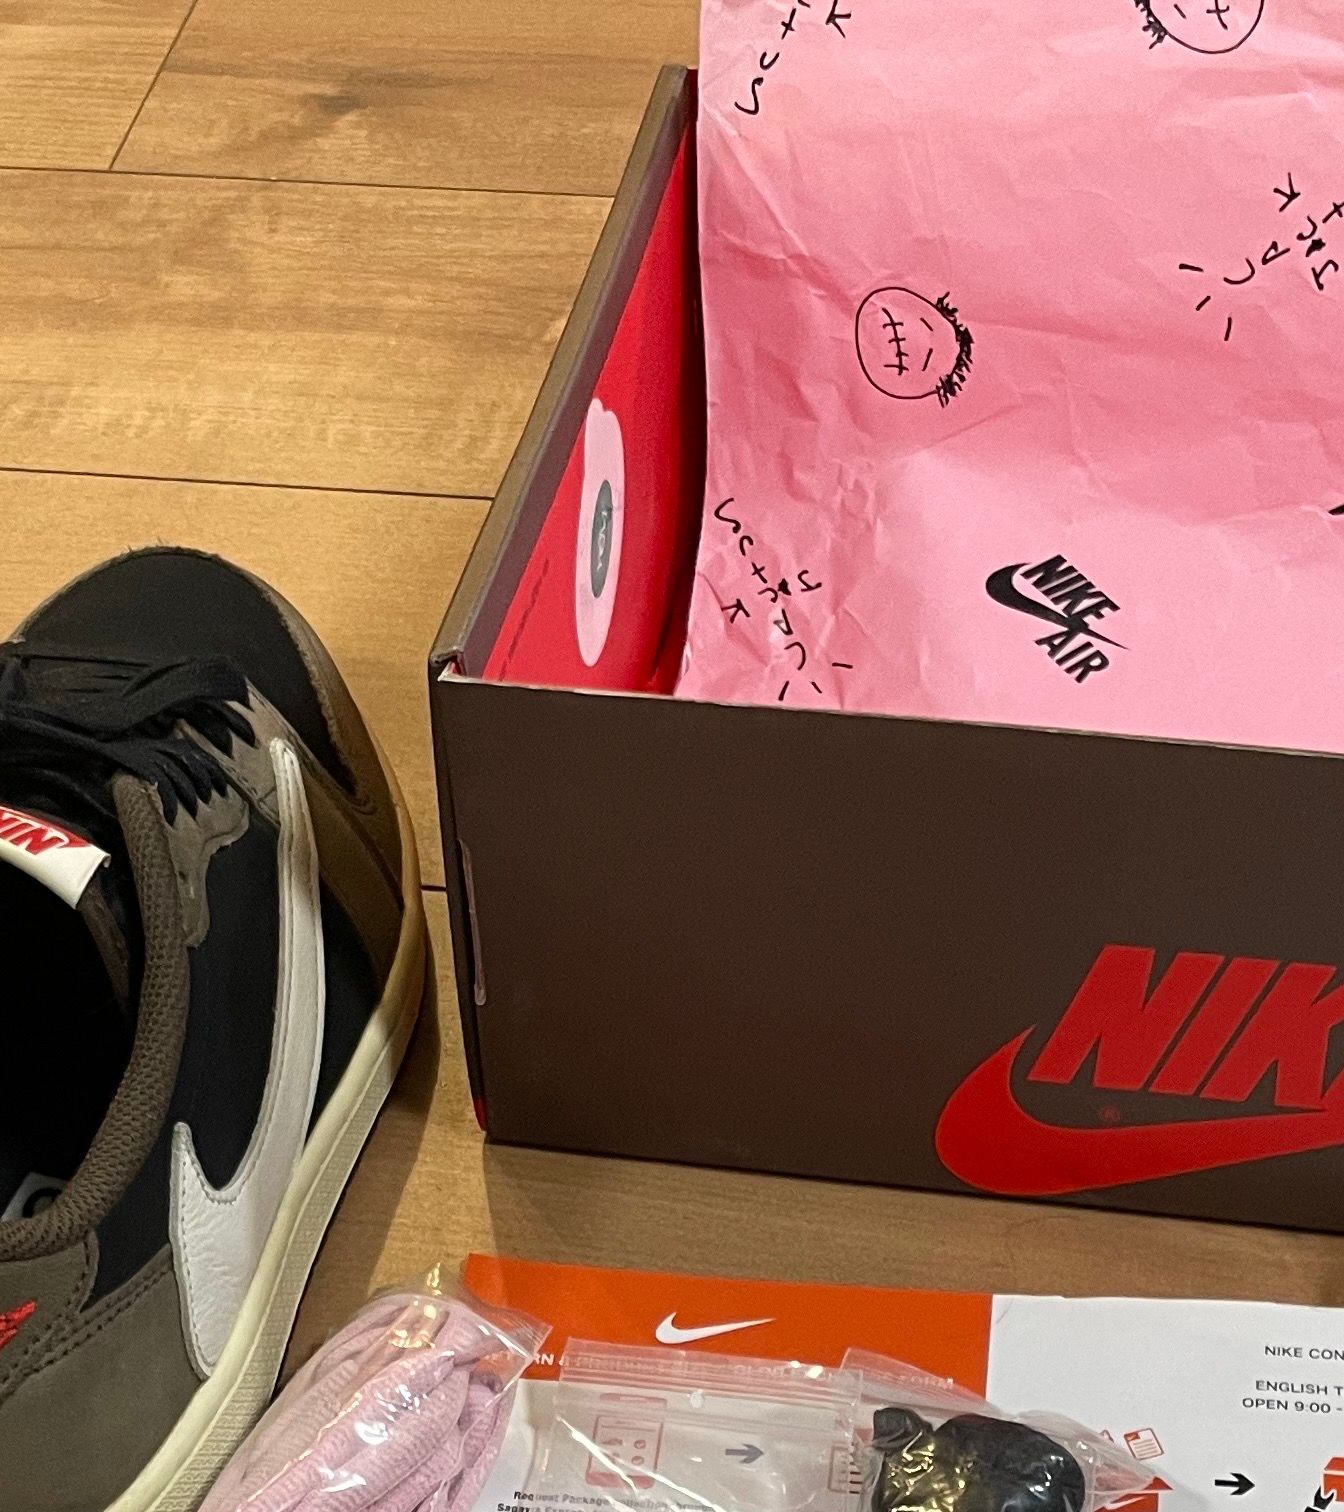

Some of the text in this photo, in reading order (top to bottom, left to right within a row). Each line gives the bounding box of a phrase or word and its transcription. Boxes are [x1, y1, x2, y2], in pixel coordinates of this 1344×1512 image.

[1020, 554, 1121, 628] NIKE
[1034, 628, 1109, 684] AIR
[1265, 1346, 1302, 1357] NIKE
[1256, 1381, 1327, 1395] ENGLISH
[1243, 1398, 1288, 1410] OPEN
[1295, 1402, 1330, 1413] 9:00
